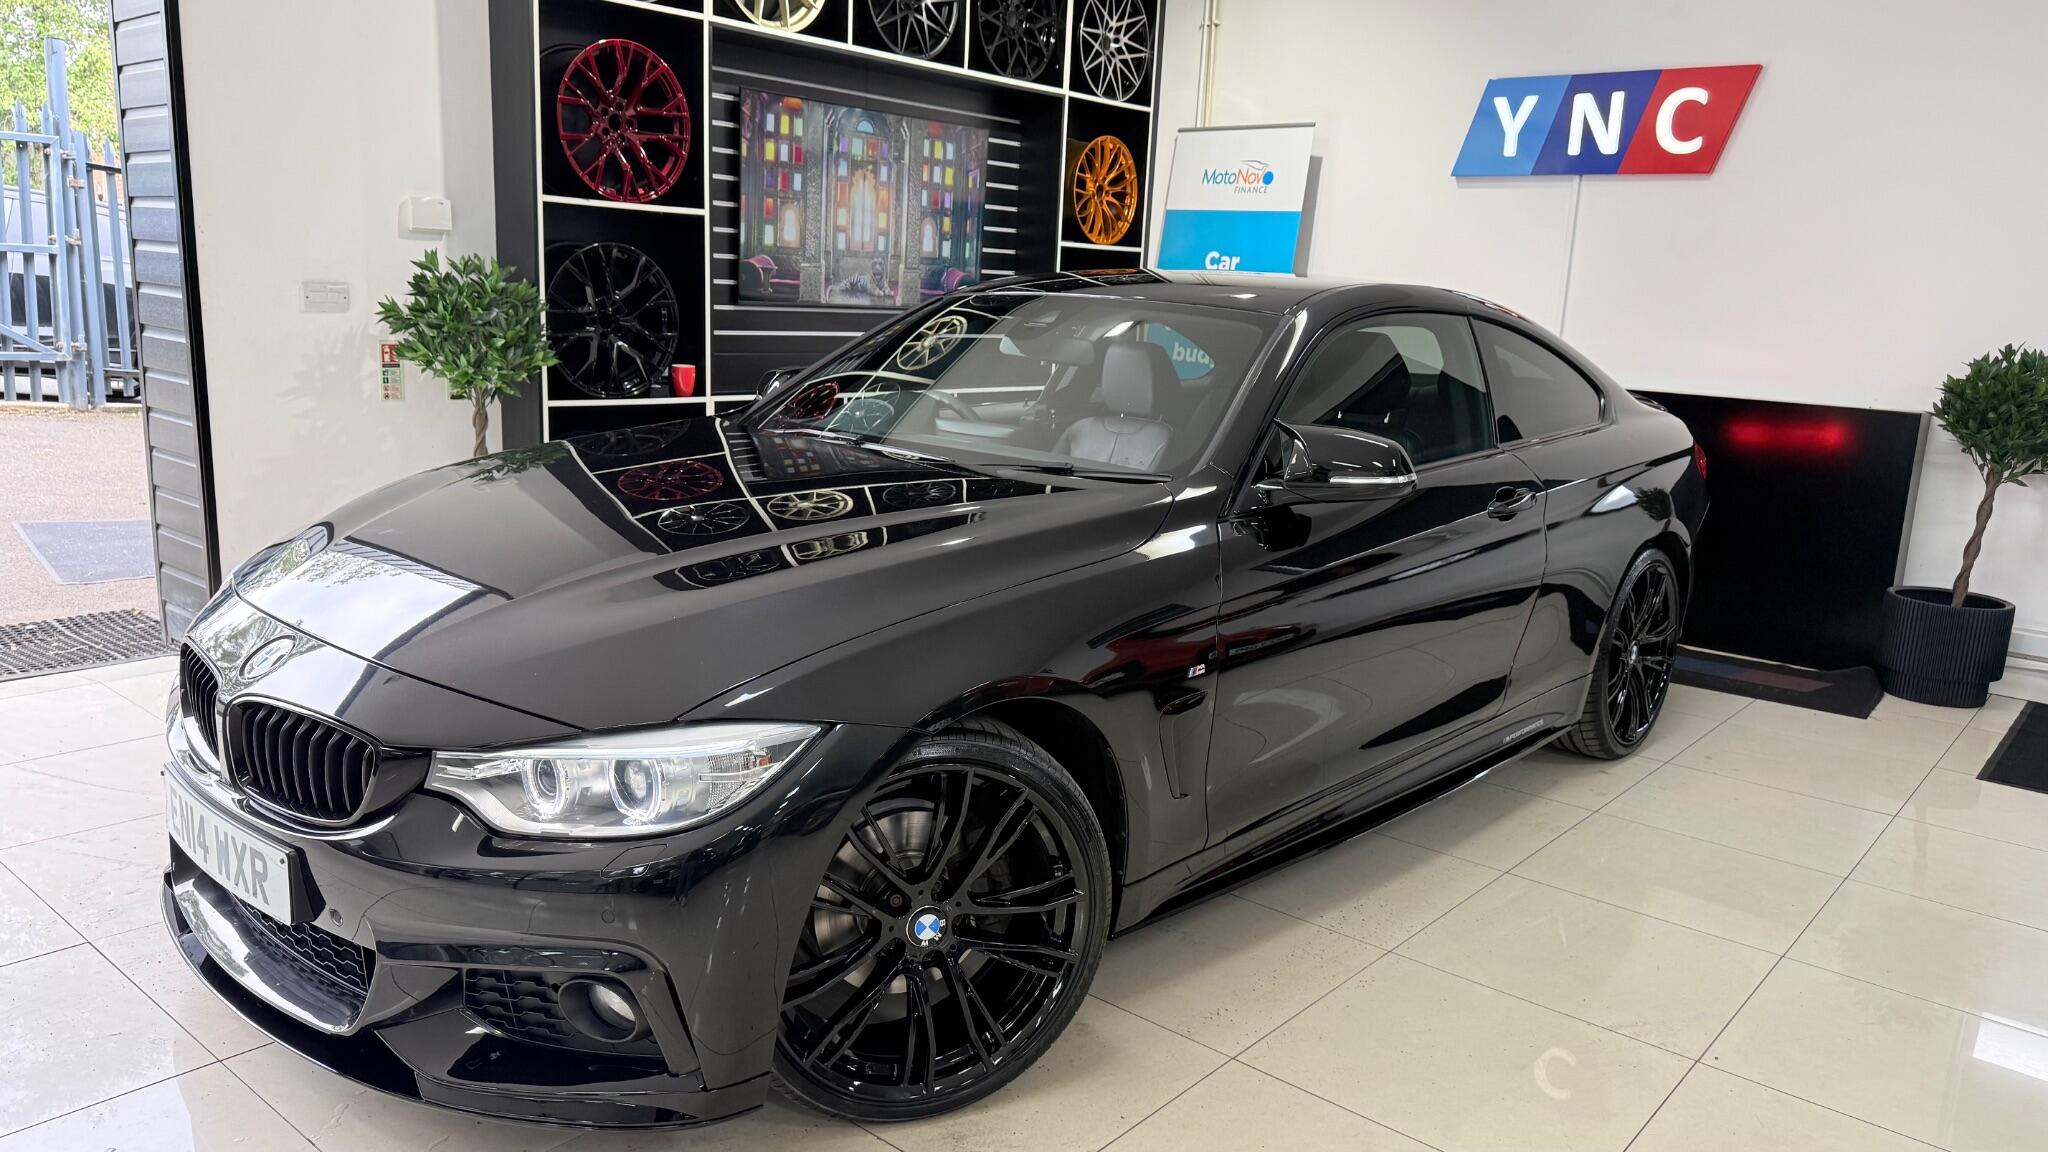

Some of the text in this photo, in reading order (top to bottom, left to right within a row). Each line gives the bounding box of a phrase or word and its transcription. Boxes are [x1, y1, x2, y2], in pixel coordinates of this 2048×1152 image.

[1493, 86, 1709, 158] YNC
[1234, 185, 1269, 195] FINANCE
[1204, 250, 1241, 271] Car
[1172, 341, 1213, 365] bud
[213, 824, 271, 906] WXR
